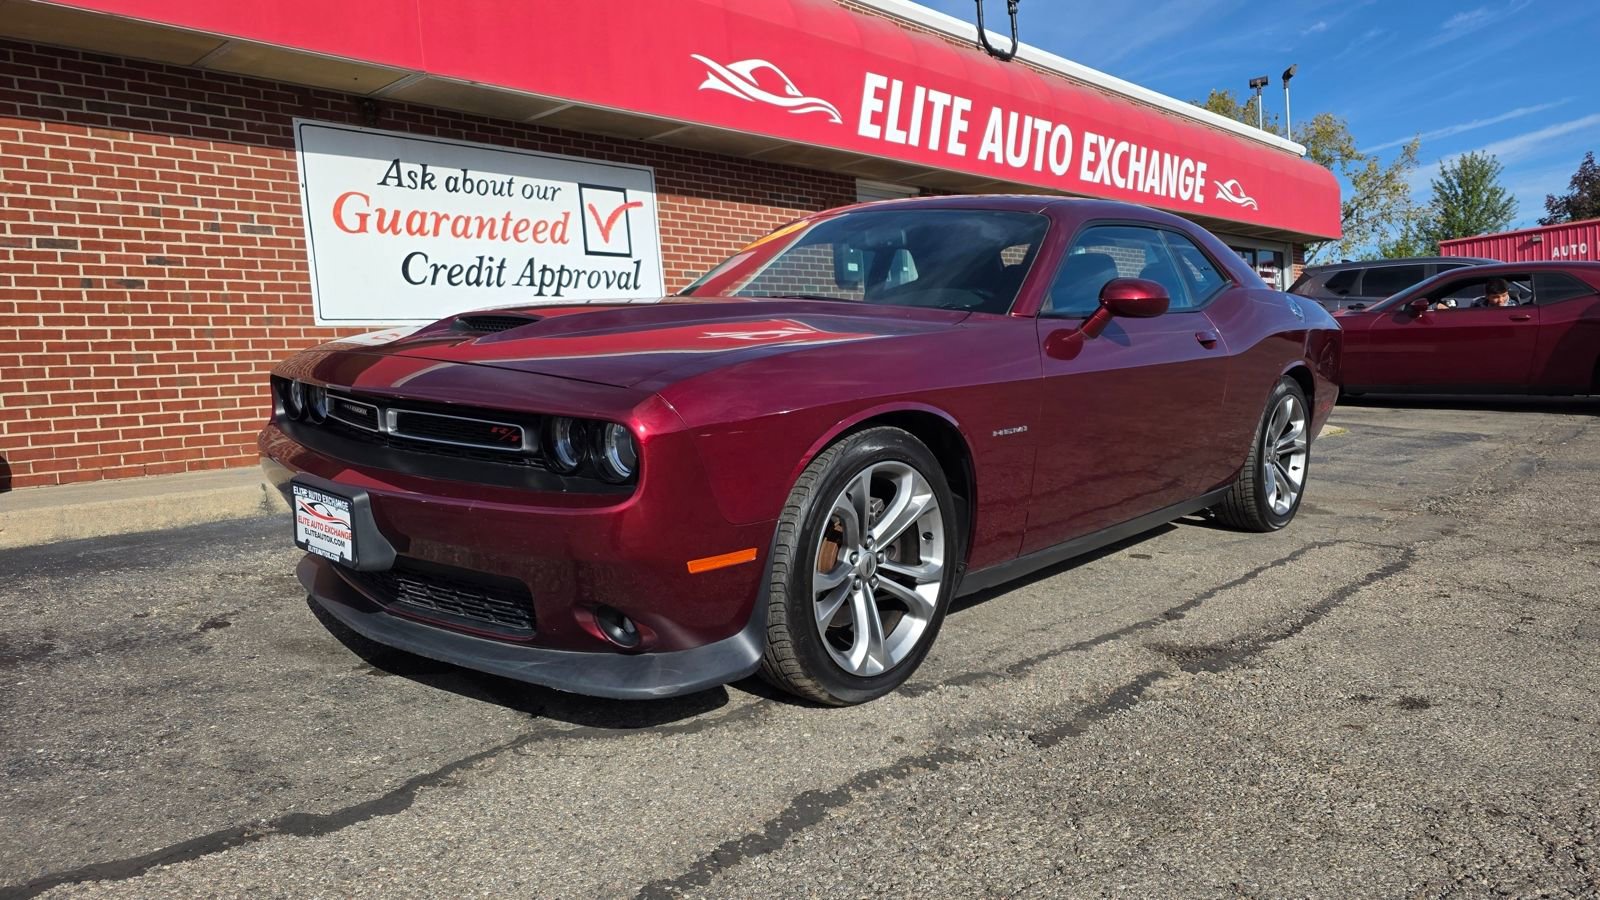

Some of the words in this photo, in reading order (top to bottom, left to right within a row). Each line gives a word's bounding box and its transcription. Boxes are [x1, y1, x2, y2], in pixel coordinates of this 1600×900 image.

[857, 71, 973, 157] ELITE
[977, 106, 1073, 175] AUTO
[1079, 131, 1208, 204] EXCHANGE
[377, 158, 437, 191] Ask
[445, 168, 515, 198] about
[522, 183, 562, 202] our
[332, 191, 571, 245] Guaranteed
[1552, 243, 1588, 258] AUTO
[401, 251, 506, 289] Credit
[512, 257, 642, 297] Approval
[293, 485, 308, 498] ELITE
[309, 490, 321, 502] AUTO
[322, 494, 349, 511] EXCHANGE
[298, 515, 310, 527] ELITE
[311, 520, 324, 531] AUTO
[325, 524, 352, 541] EXCHANGE
